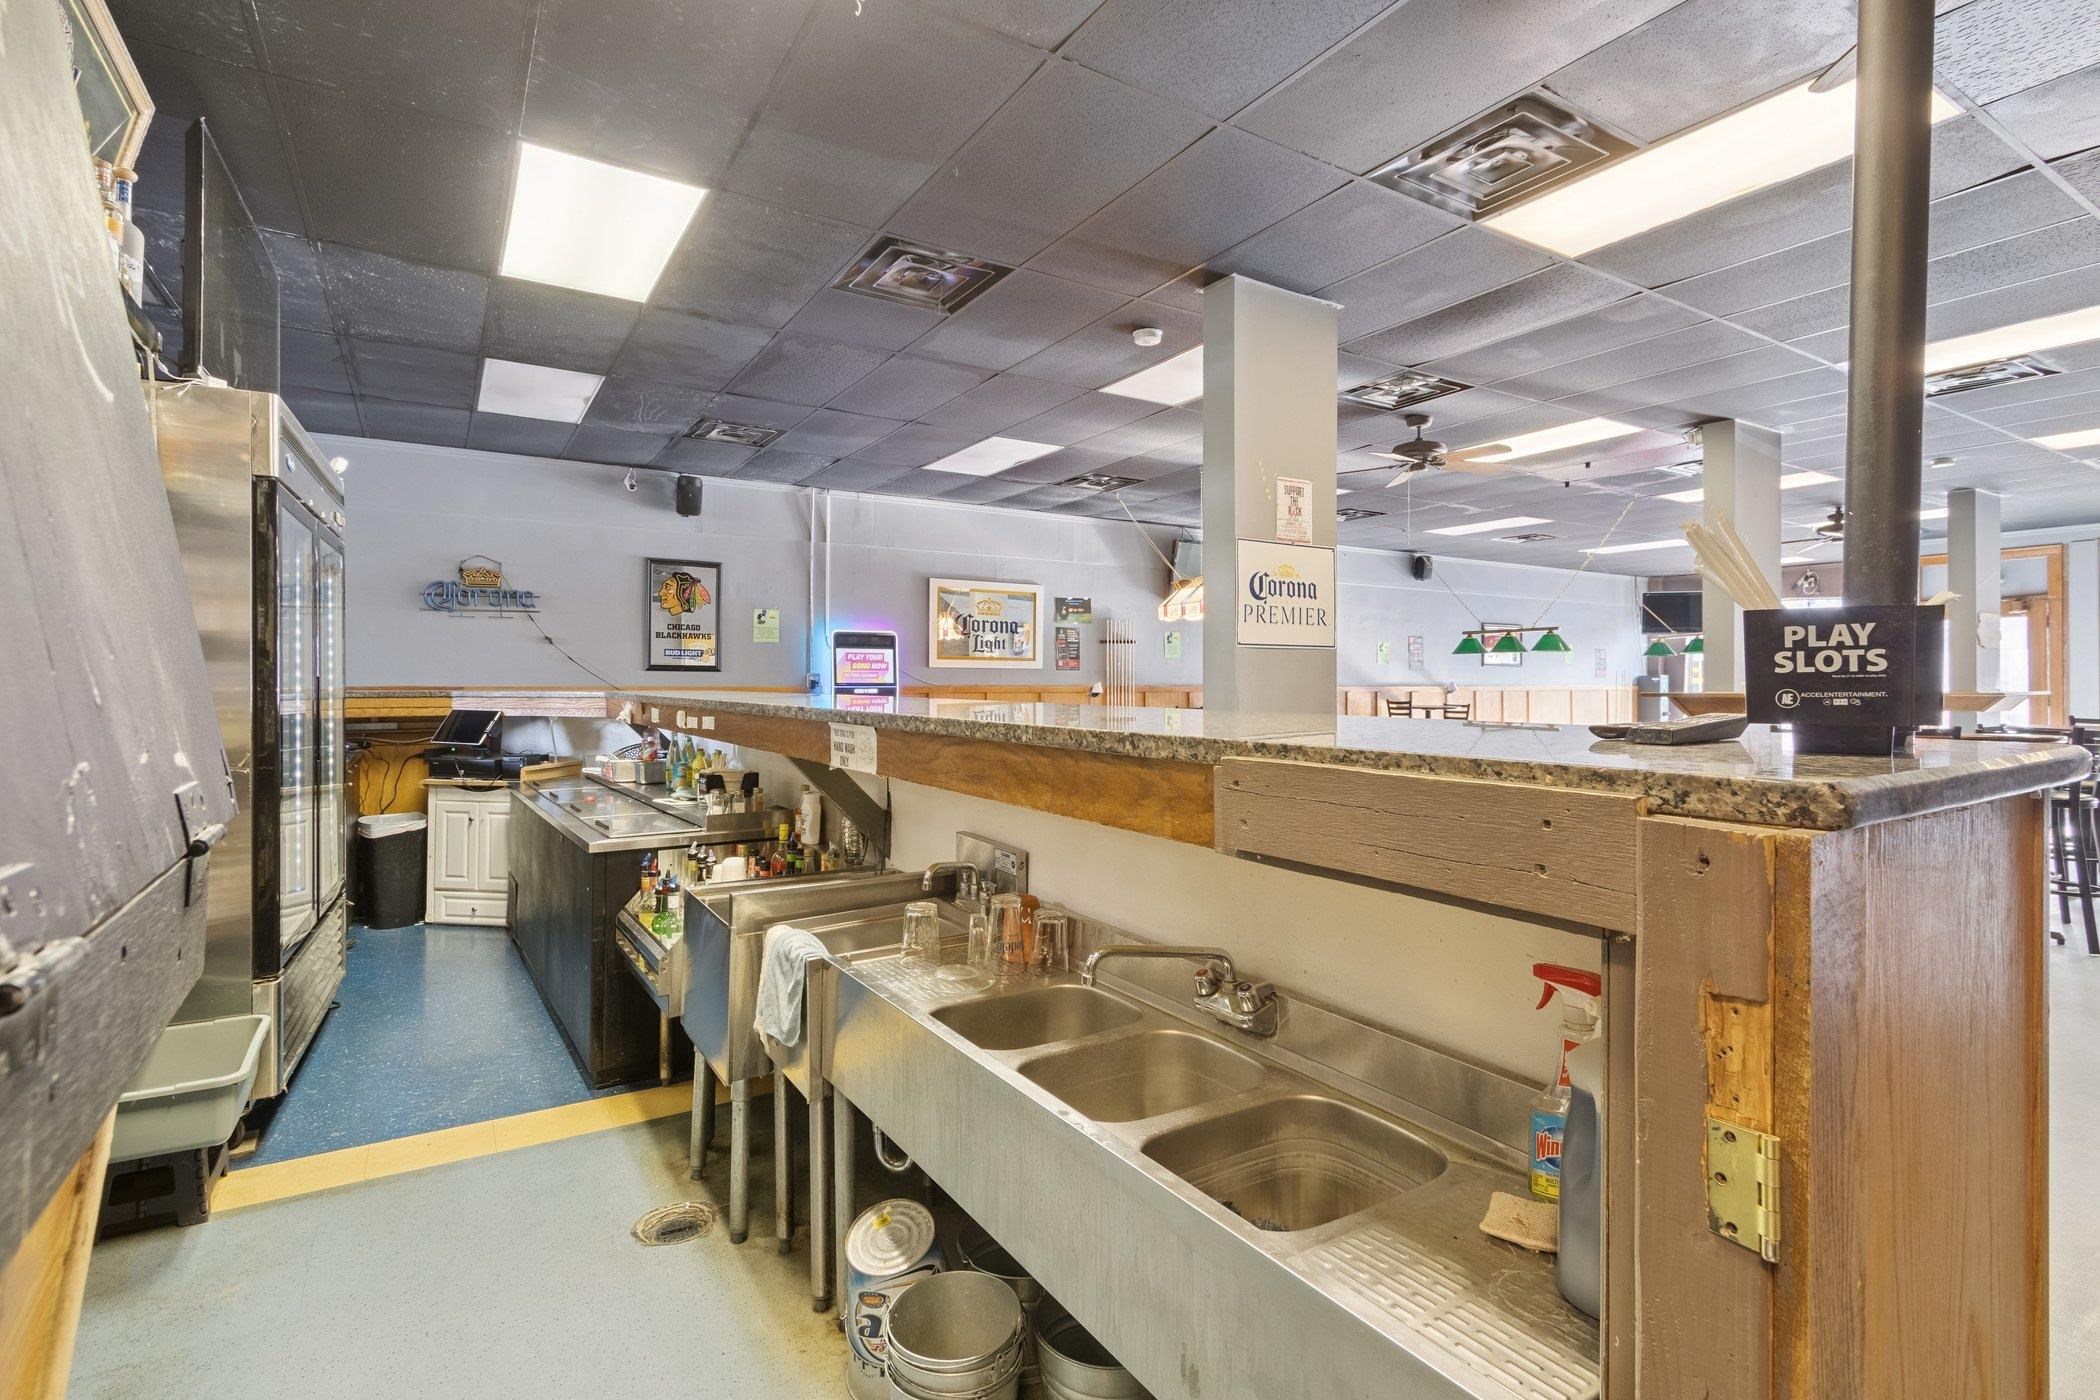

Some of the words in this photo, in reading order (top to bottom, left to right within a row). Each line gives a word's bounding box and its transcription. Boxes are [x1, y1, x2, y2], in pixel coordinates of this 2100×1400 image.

[424, 581, 536, 612] Corona
[1249, 571, 1318, 604] Corona
[667, 623, 701, 631] CHICAGO
[954, 613, 1019, 638] Corona
[1243, 604, 1327, 627] PREMIER
[655, 631, 712, 640] BLACKHAWKS
[972, 634, 1007, 654] Light
[1783, 622, 1877, 648] PLAY
[1774, 648, 1888, 673] SLOTS
